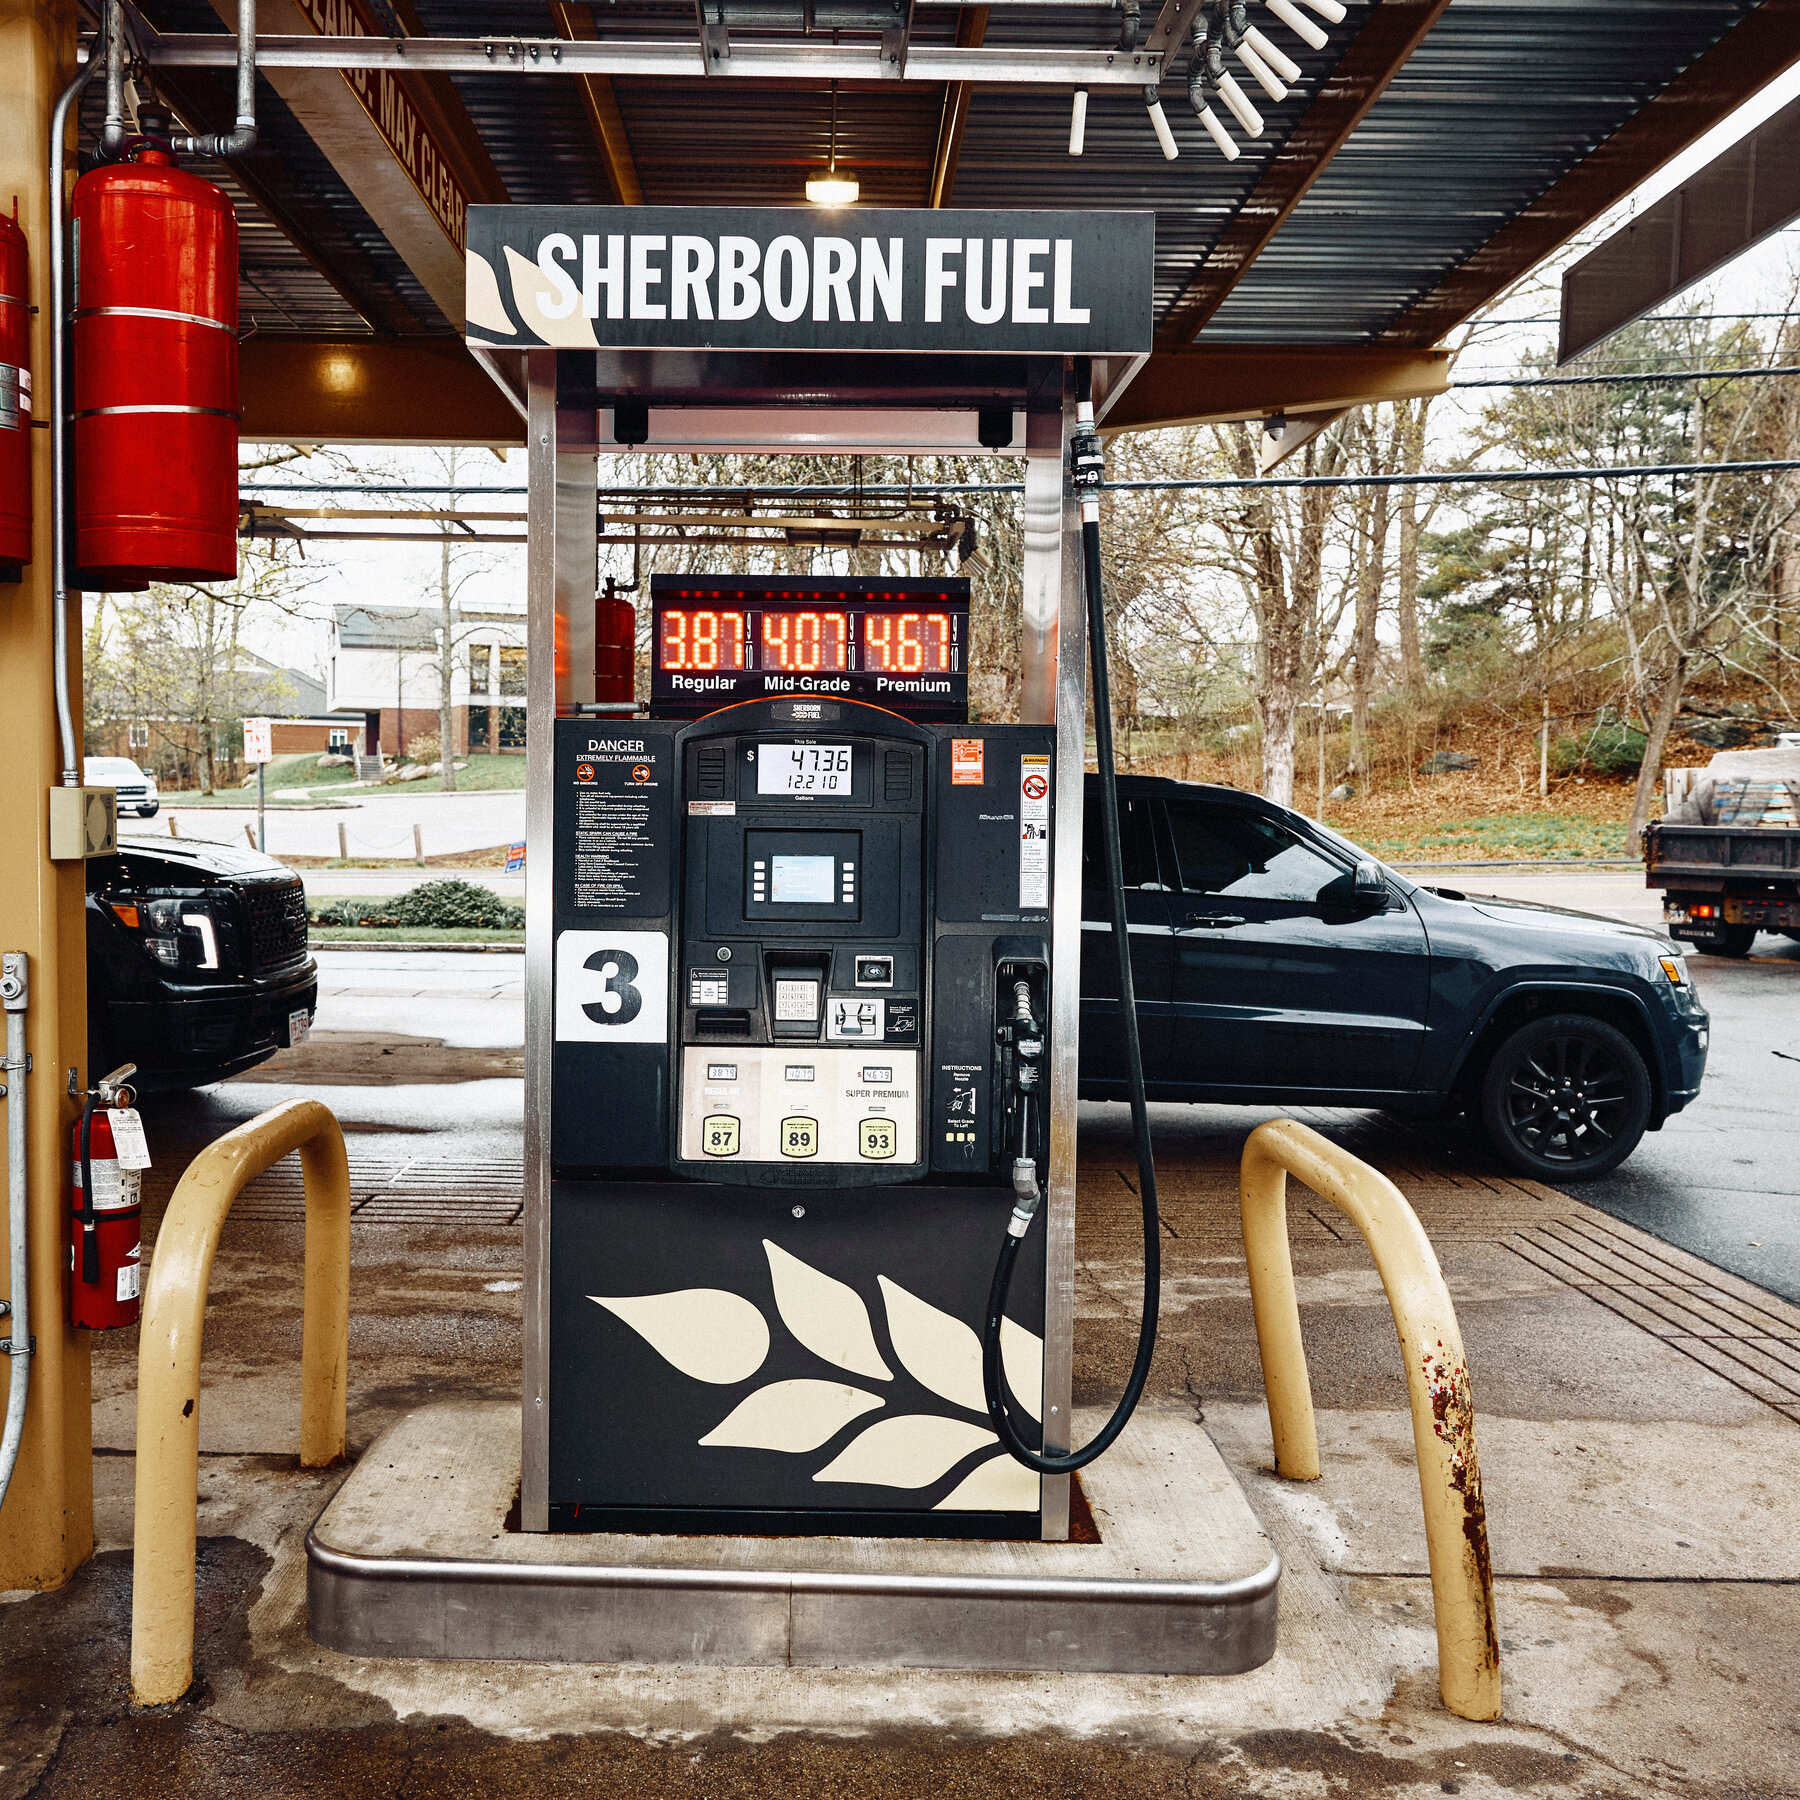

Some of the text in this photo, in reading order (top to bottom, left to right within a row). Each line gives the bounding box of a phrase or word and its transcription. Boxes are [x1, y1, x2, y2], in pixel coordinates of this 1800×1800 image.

[380, 68, 417, 179] MAX
[421, 132, 464, 250] CLEAR
[535, 232, 1091, 325] SHERBORN FUEL
[664, 610, 744, 670] 3.87
[763, 612, 845, 671] 4.07
[865, 614, 948, 672] 4.67
[671, 675, 736, 693] Regular
[764, 676, 850, 692] Mid-Grade
[876, 678, 951, 692] Premium
[793, 704, 821, 712] SHERBORN
[807, 711, 821, 719] FUEL
[588, 739, 645, 752] DANGER
[614, 755, 656, 763] FLAMMABLE
[746, 750, 849, 771] $ 47.36
[788, 775, 838, 789] 12.210
[580, 949, 642, 1025] 3
[845, 1089, 909, 1098] SUPER PREMIUM
[711, 1132, 733, 1146] 87
[788, 1132, 810, 1147] 89
[867, 1134, 889, 1149] 93
